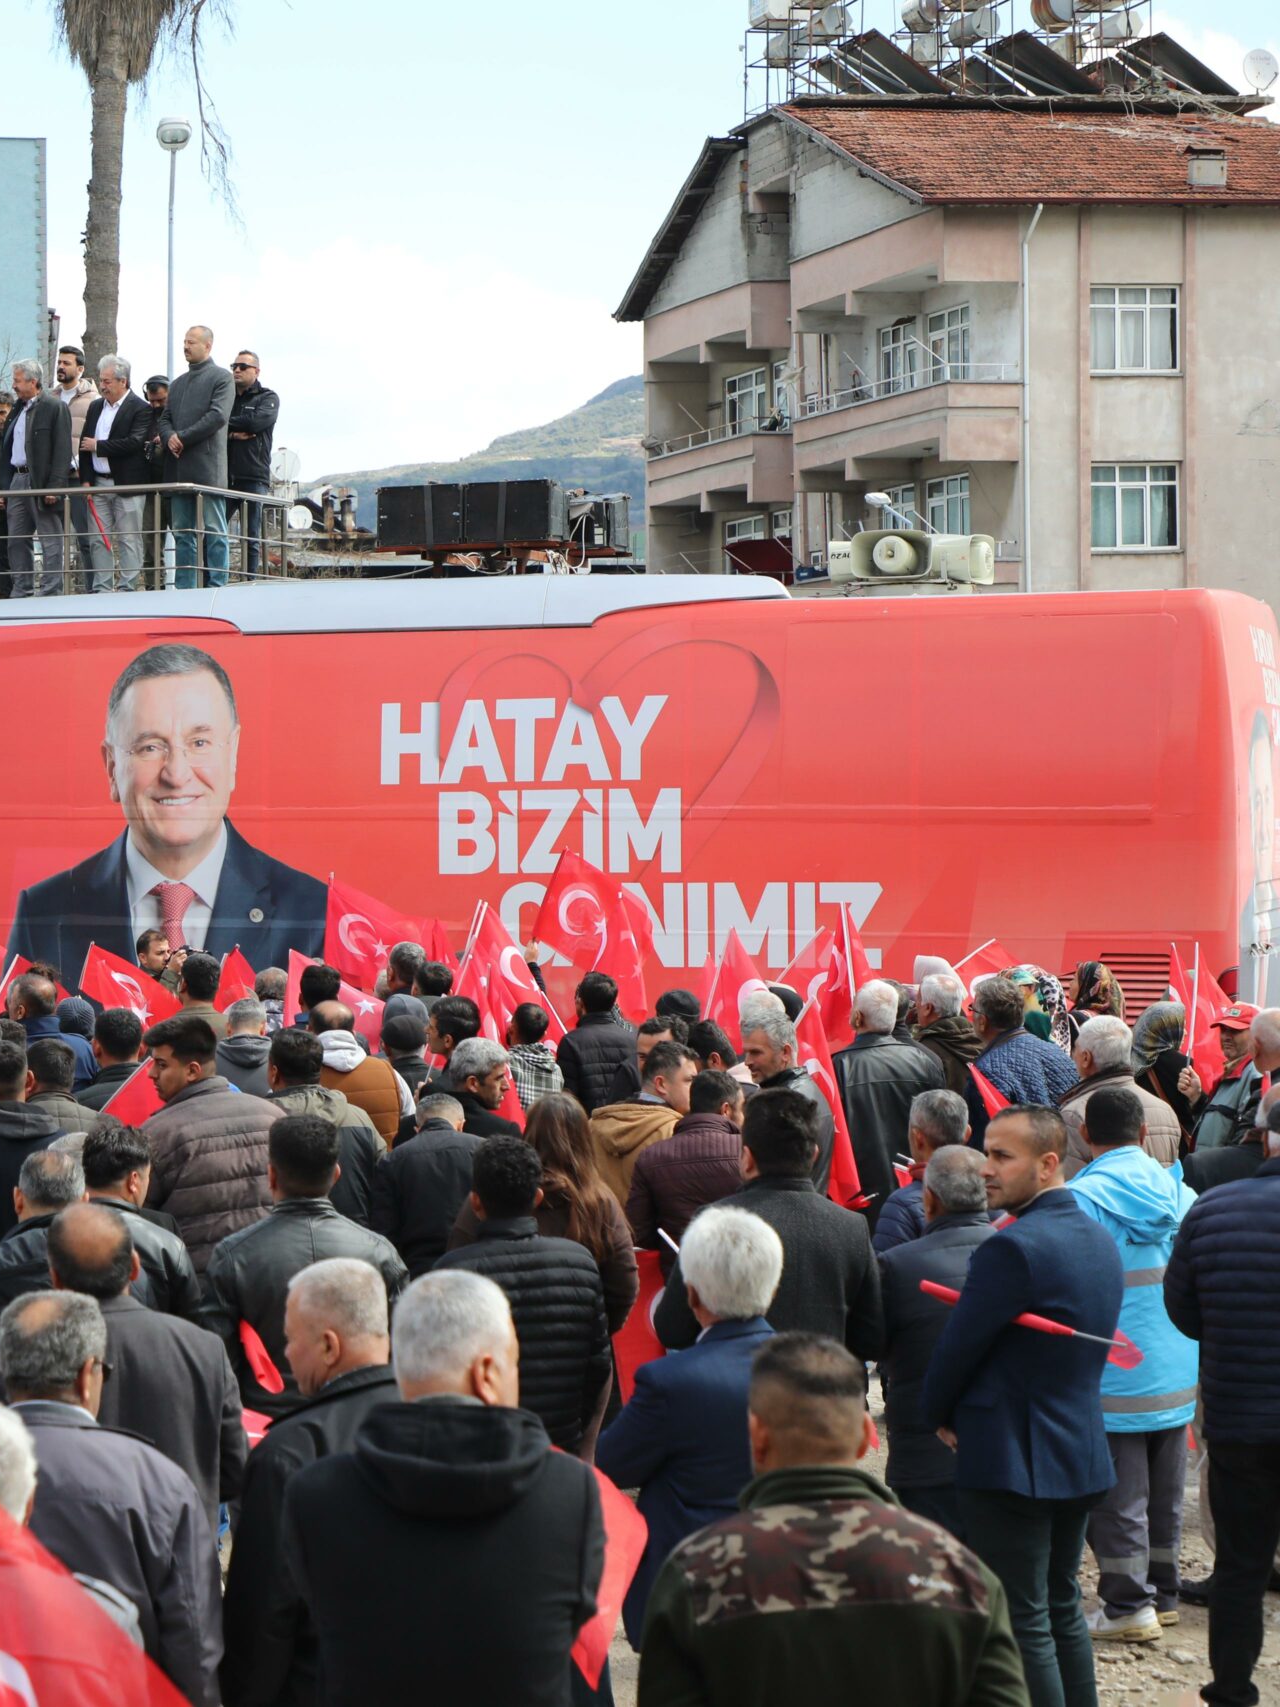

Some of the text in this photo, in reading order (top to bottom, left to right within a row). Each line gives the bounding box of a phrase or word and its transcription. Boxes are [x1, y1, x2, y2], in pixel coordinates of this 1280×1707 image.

[380, 695, 669, 785] HATAY
[438, 787, 682, 875] BİZİM
[499, 881, 884, 969] CNIMIZ
